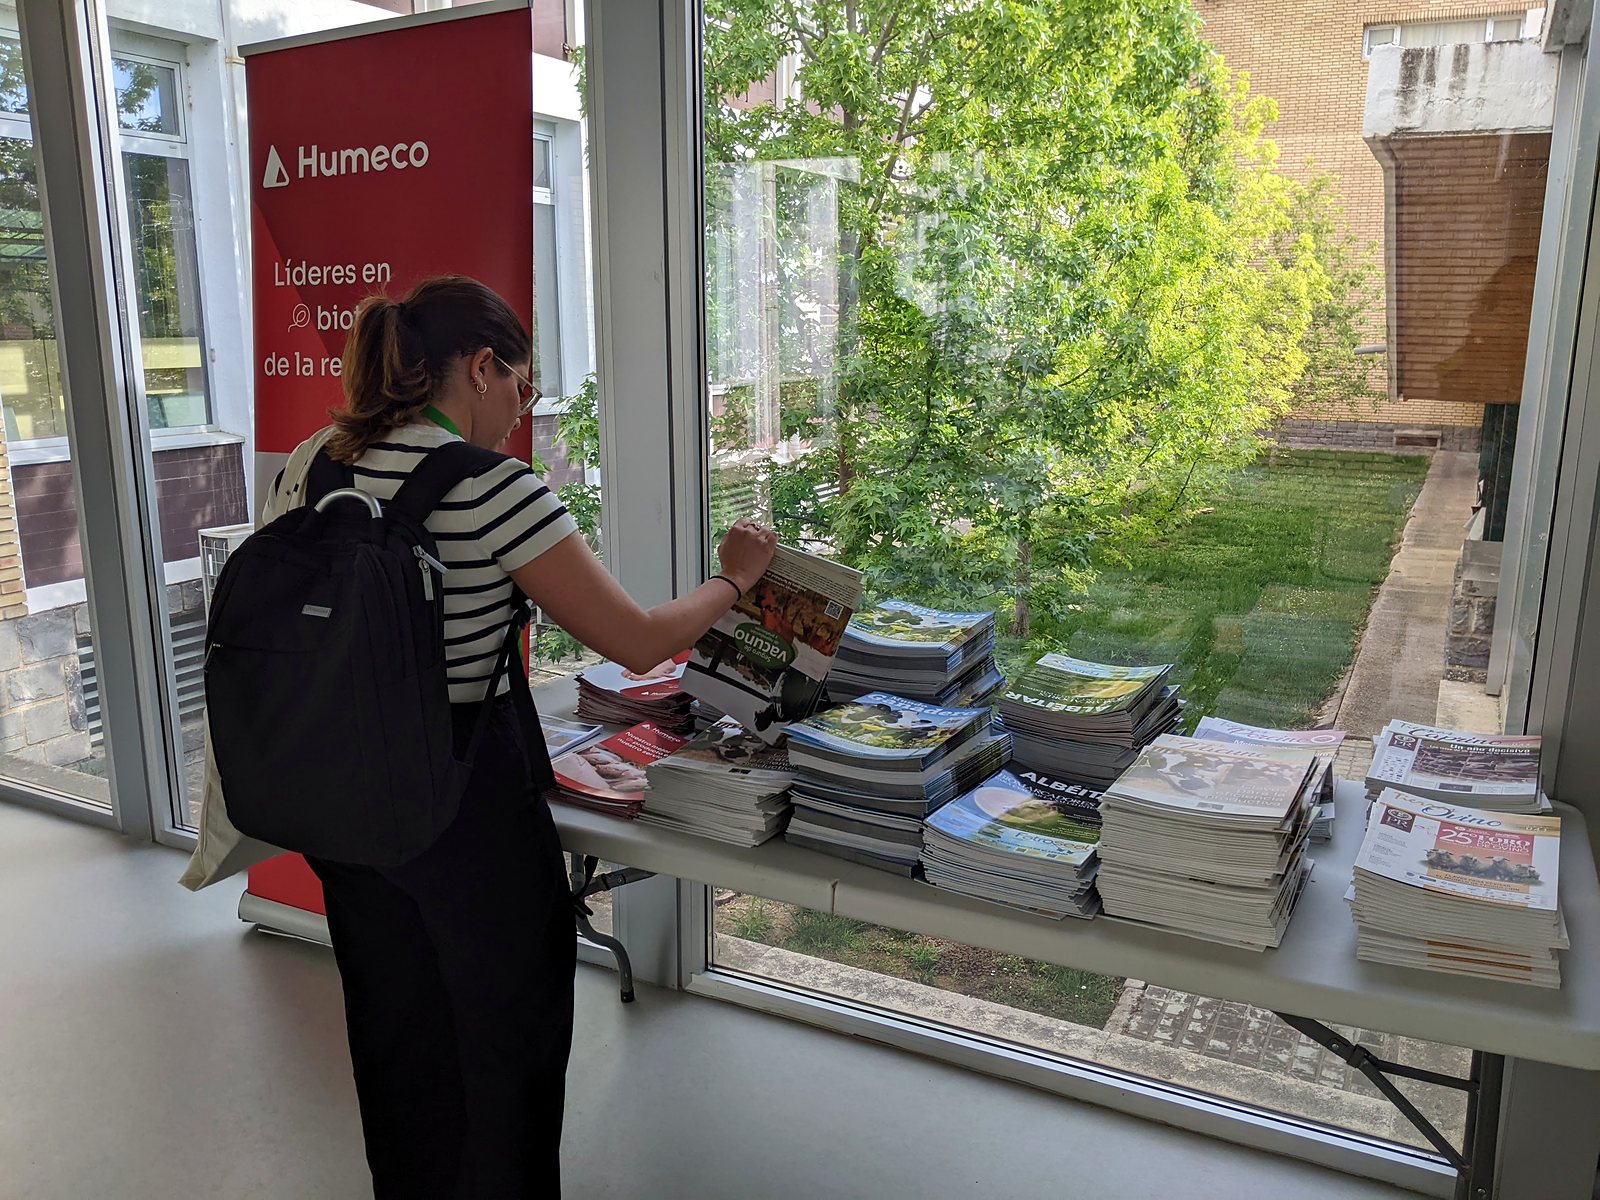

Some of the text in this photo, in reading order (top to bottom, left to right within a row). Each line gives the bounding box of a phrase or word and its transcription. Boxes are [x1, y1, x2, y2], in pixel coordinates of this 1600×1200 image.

[298, 141, 430, 178] Humeco
[274, 258, 391, 286] Líderes en
[264, 353, 290, 377] de
[295, 352, 314, 376] la
[734, 629, 787, 663] vacuno
[1005, 690, 1112, 714] ALBÉITAR
[652, 727, 681, 743] Humeco
[1408, 728, 1503, 746] Caprino
[1450, 743, 1464, 751] Un
[1487, 746, 1531, 754] decisivo
[1386, 816, 1408, 828] PR
[1421, 805, 1502, 828] Ovino
